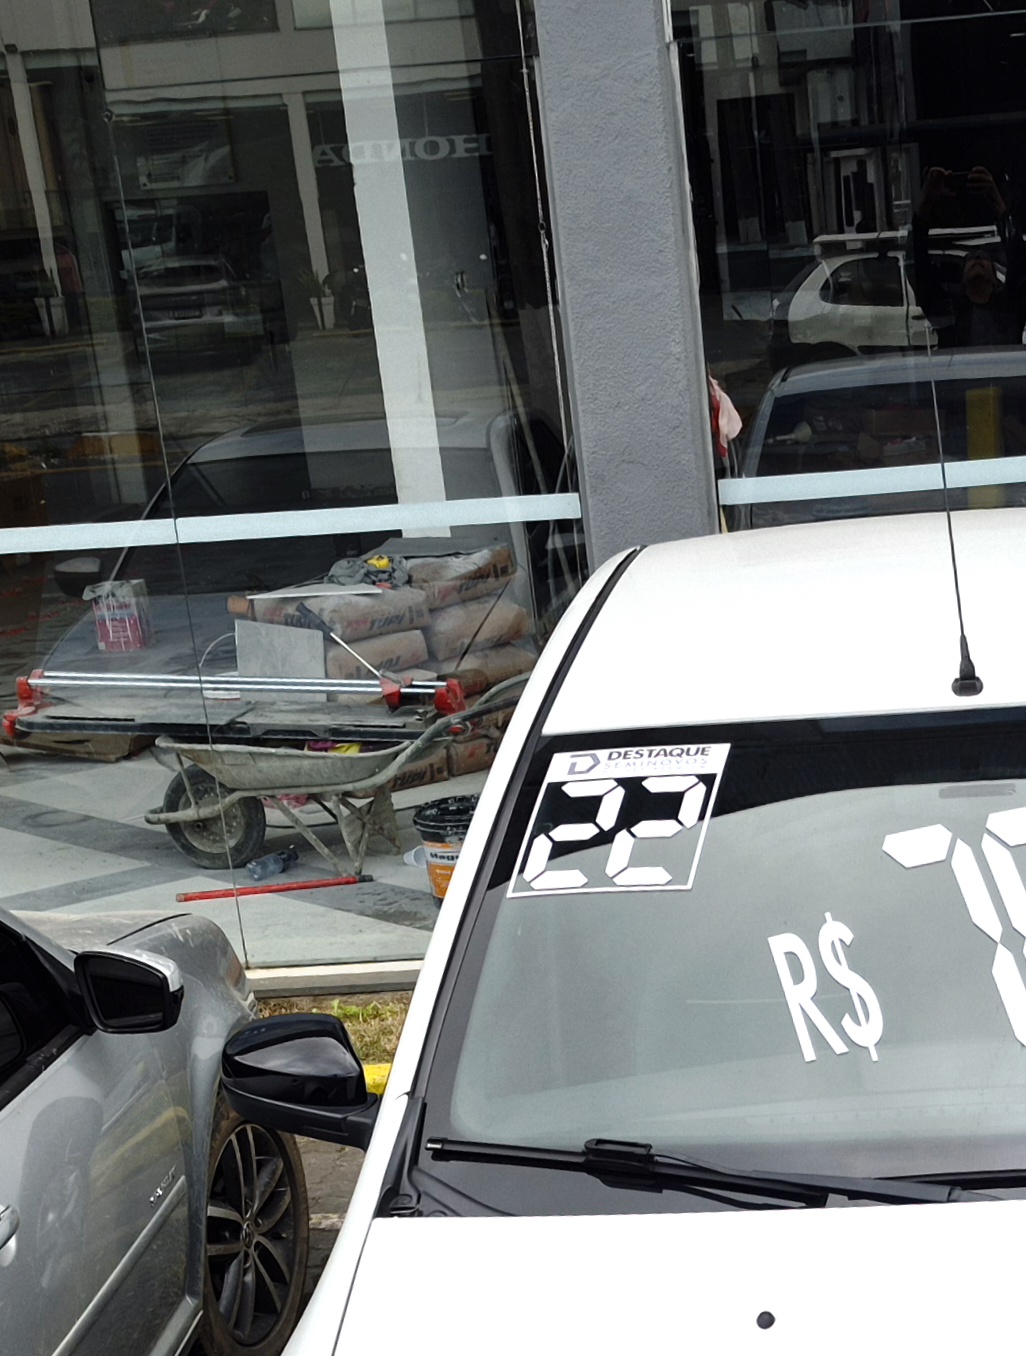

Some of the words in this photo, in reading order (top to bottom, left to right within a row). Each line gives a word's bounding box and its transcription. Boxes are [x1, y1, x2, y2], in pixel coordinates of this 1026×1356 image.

[604, 757, 709, 769] SEMINOVOS
[607, 746, 712, 761] DESTAQUE
[522, 775, 707, 890] 22
[767, 911, 884, 1063] R$
